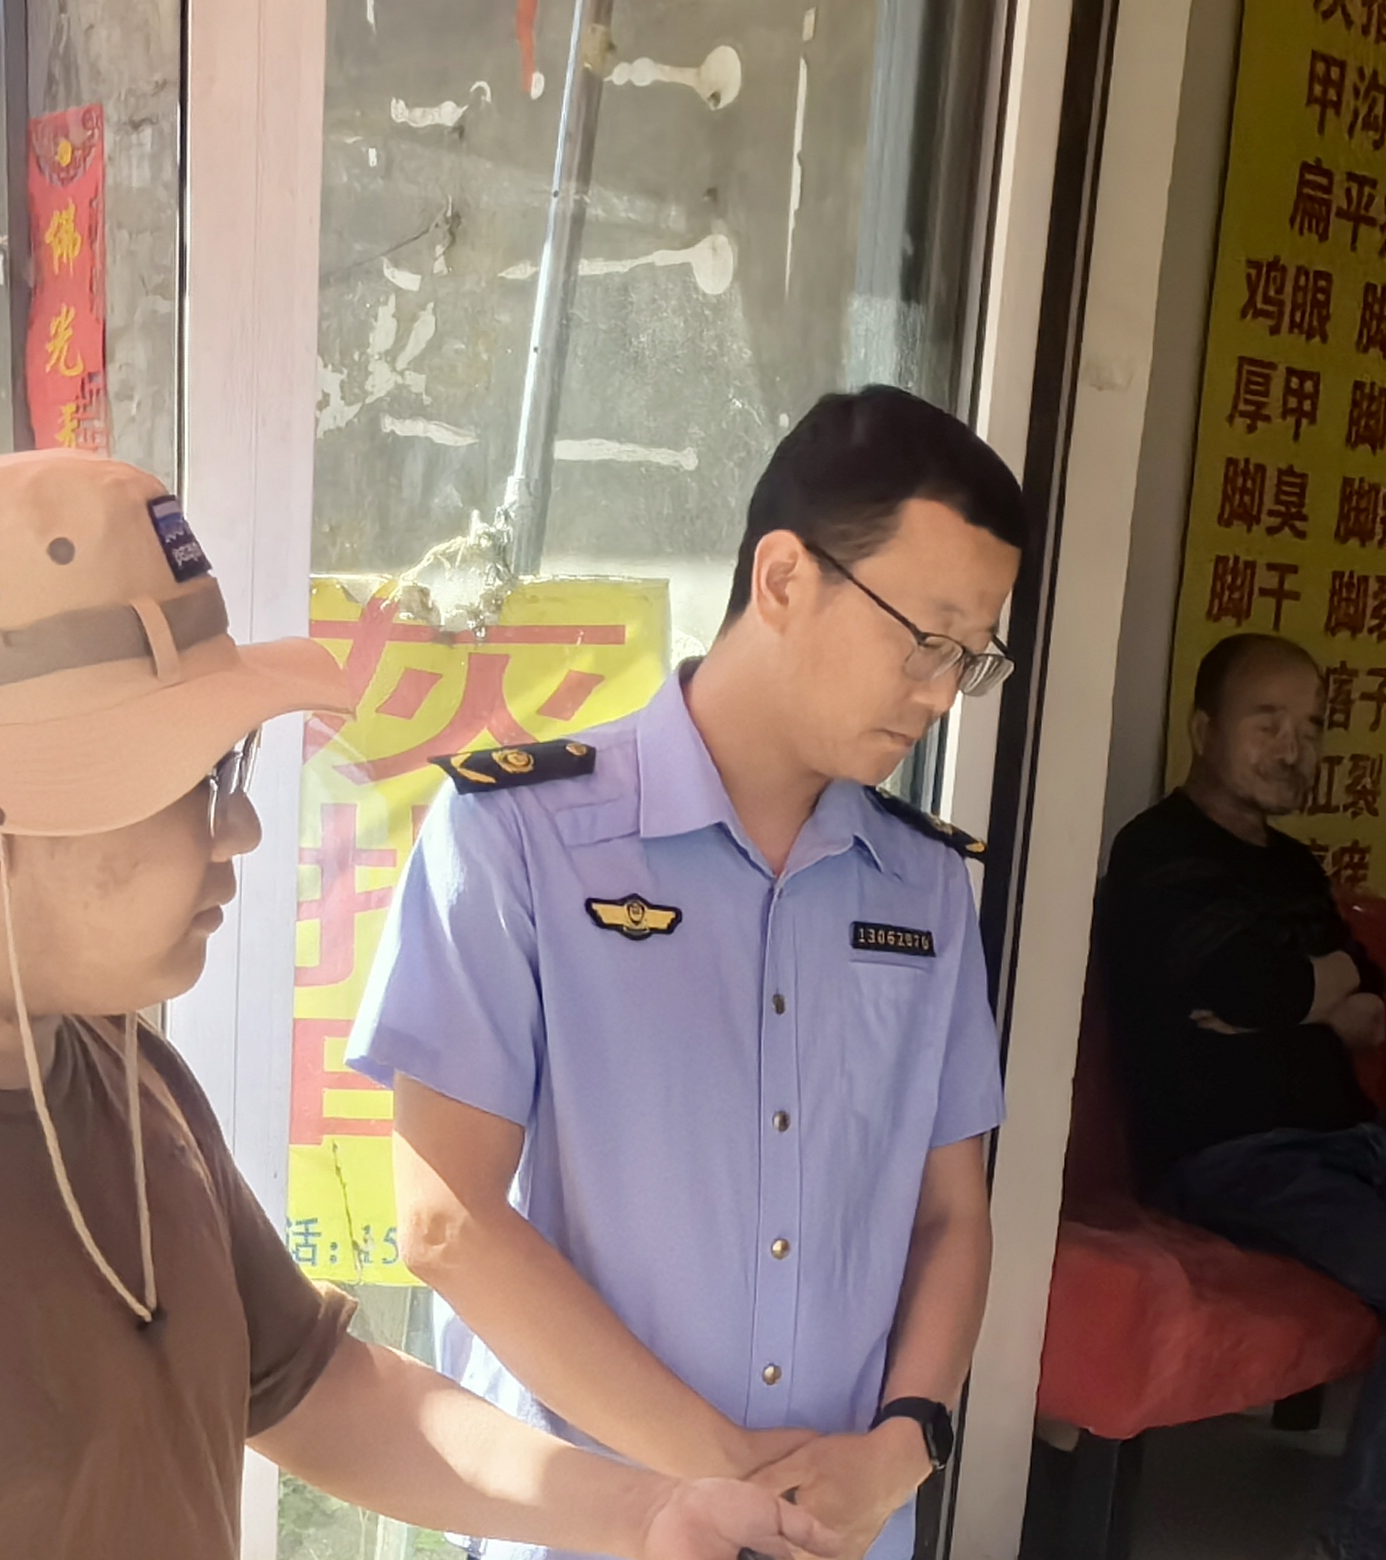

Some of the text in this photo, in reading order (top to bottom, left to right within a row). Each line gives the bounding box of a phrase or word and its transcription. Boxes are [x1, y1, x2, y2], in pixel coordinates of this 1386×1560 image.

[1240, 255, 1334, 345] 鸡眼
[1226, 355, 1321, 443] 厚甲
[1217, 457, 1310, 541] 脚臭
[1205, 554, 1302, 633] 脚干
